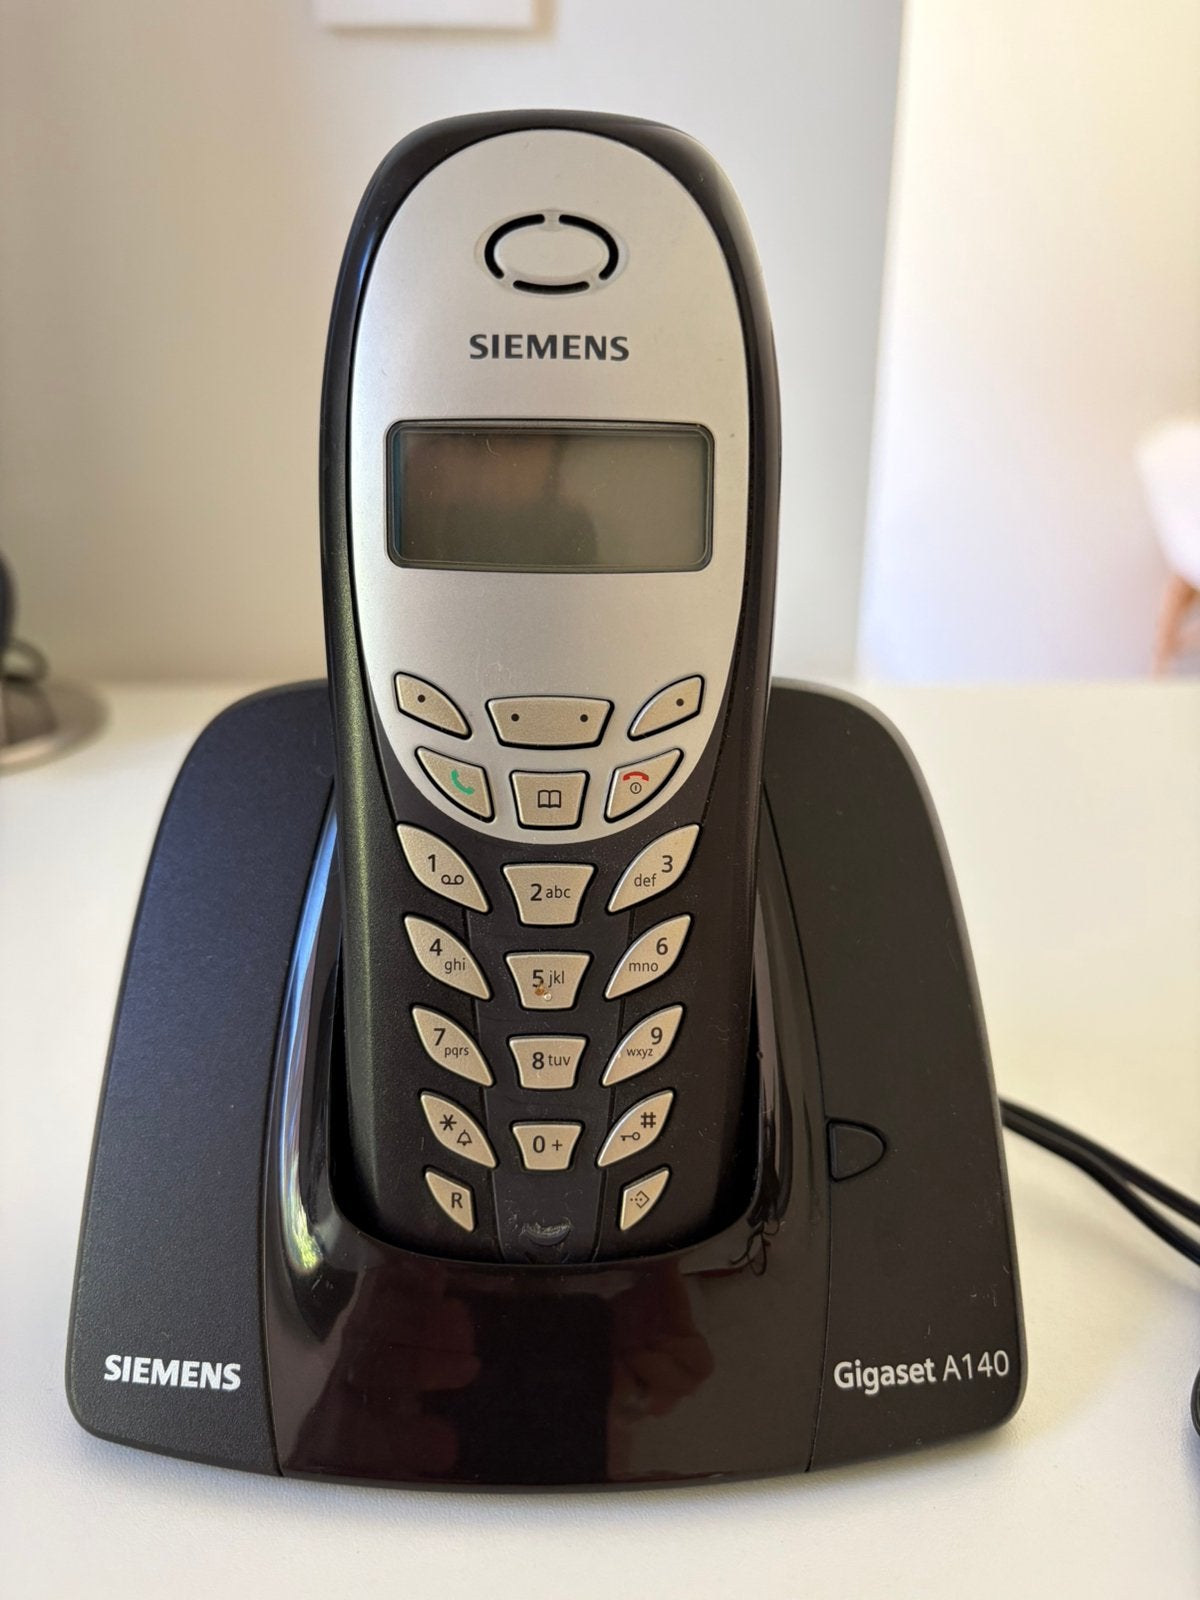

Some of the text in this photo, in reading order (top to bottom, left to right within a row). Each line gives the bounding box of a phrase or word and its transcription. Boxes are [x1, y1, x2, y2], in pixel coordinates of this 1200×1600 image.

[468, 333, 630, 362] SIEMENS
[427, 854, 436, 872] 1
[661, 855, 674, 873] 3
[633, 873, 657, 887] def
[530, 884, 571, 901] 2 abc
[429, 938, 443, 956] 4
[656, 937, 668, 955] 6
[444, 958, 466, 975] ghi
[628, 961, 659, 973] mno
[532, 970, 565, 988] 5 jkl
[433, 1028, 446, 1046] 7
[650, 1027, 663, 1045] 9
[444, 1045, 469, 1058] pqrs
[626, 1047, 653, 1058] wxyz
[532, 1052, 571, 1070] 8 tuv
[533, 1135, 545, 1153] 0
[451, 1192, 463, 1208] R
[104, 1354, 241, 1391] SIEMENS
[834, 1350, 1009, 1395] Gigaset A140
